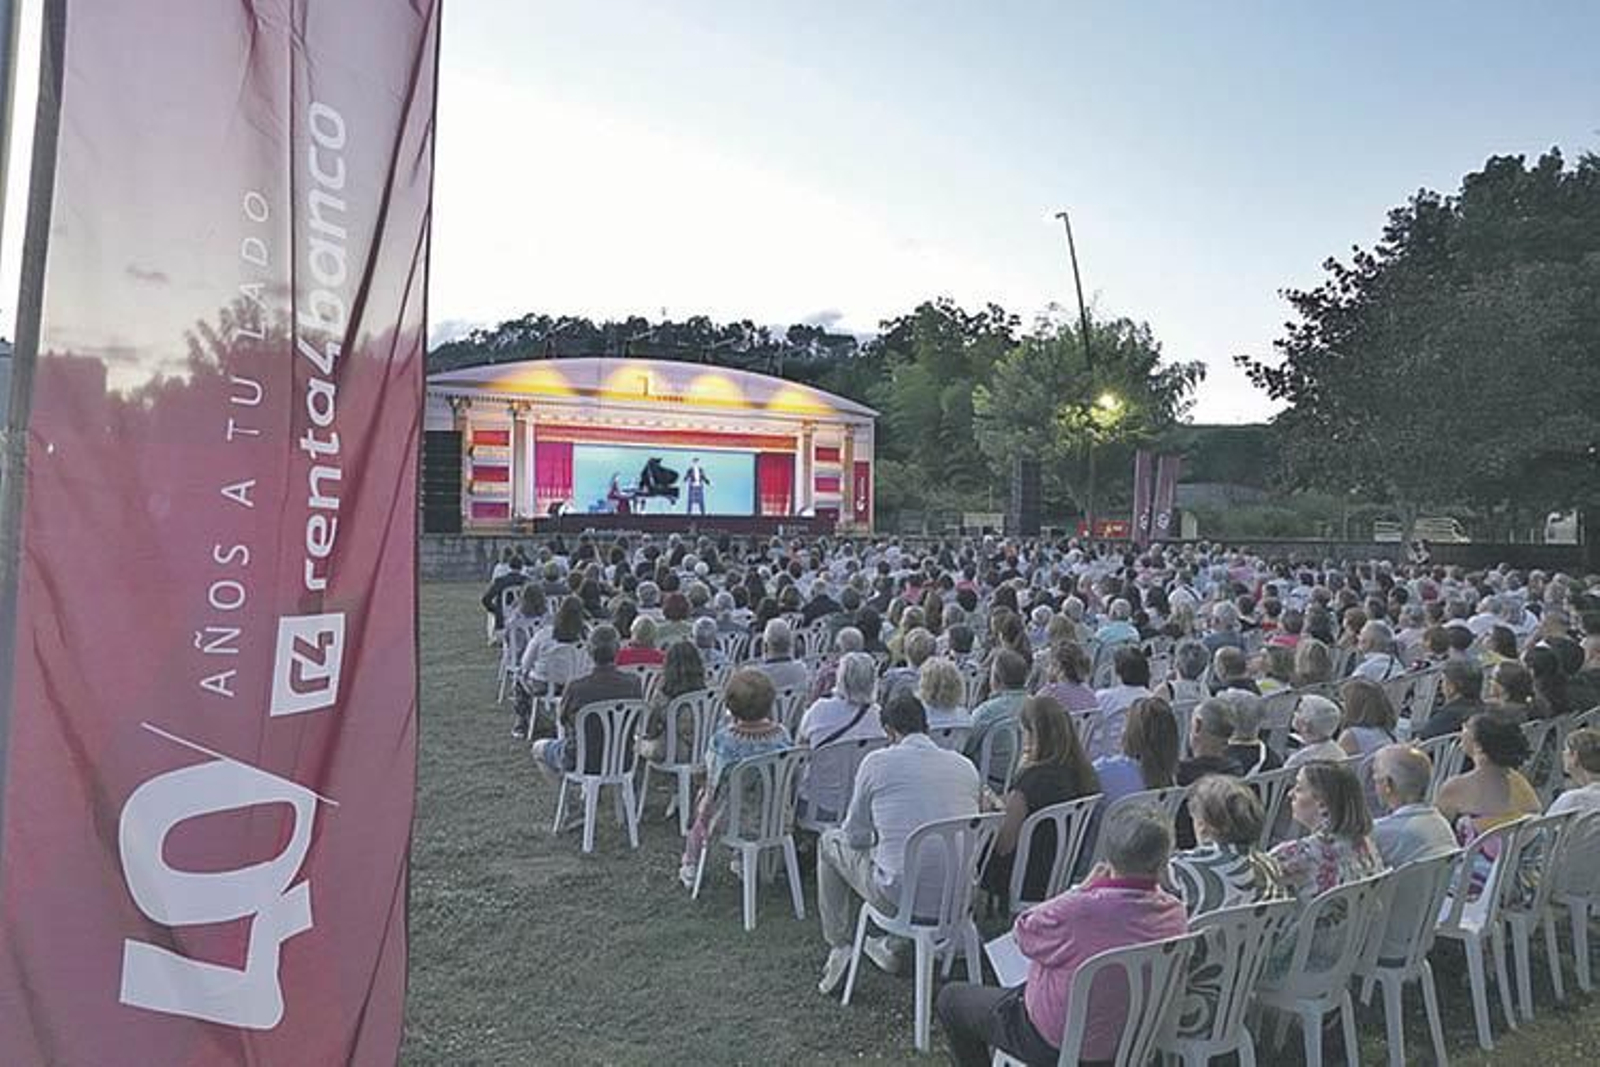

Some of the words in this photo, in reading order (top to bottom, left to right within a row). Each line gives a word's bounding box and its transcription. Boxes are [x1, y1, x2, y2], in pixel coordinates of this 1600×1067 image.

[236, 190, 270, 341] LADO
[226, 374, 264, 441] TU
[297, 100, 347, 590] renta4banco
[220, 478, 257, 508] A
[193, 543, 250, 698] AÑOS
